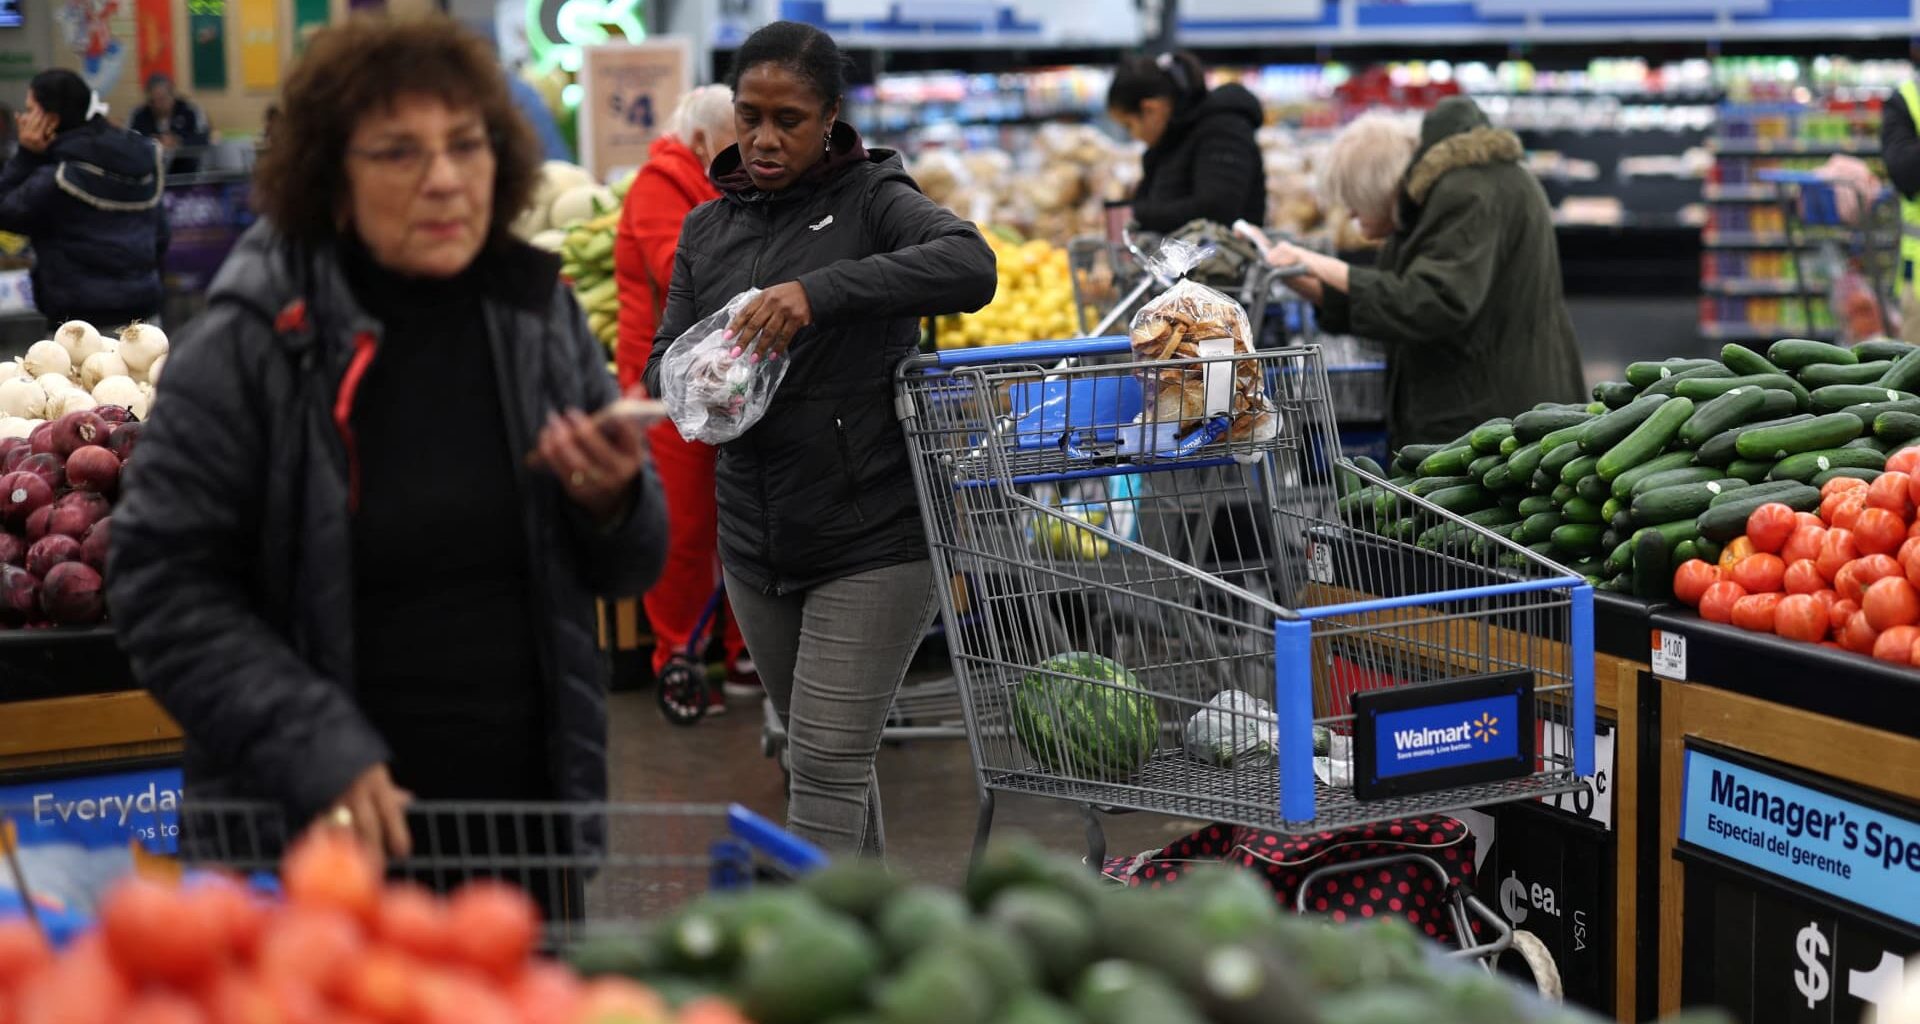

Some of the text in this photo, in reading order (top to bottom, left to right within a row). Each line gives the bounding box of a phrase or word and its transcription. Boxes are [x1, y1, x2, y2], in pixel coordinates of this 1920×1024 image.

[1394, 721, 1472, 751] Walmart
[1436, 744, 1450, 754] Live
[1710, 769, 1859, 850] Manager's
[1708, 813, 1852, 880] Especial del gerente
[1530, 881, 1561, 917] ea.
[1573, 909, 1587, 952] USA
